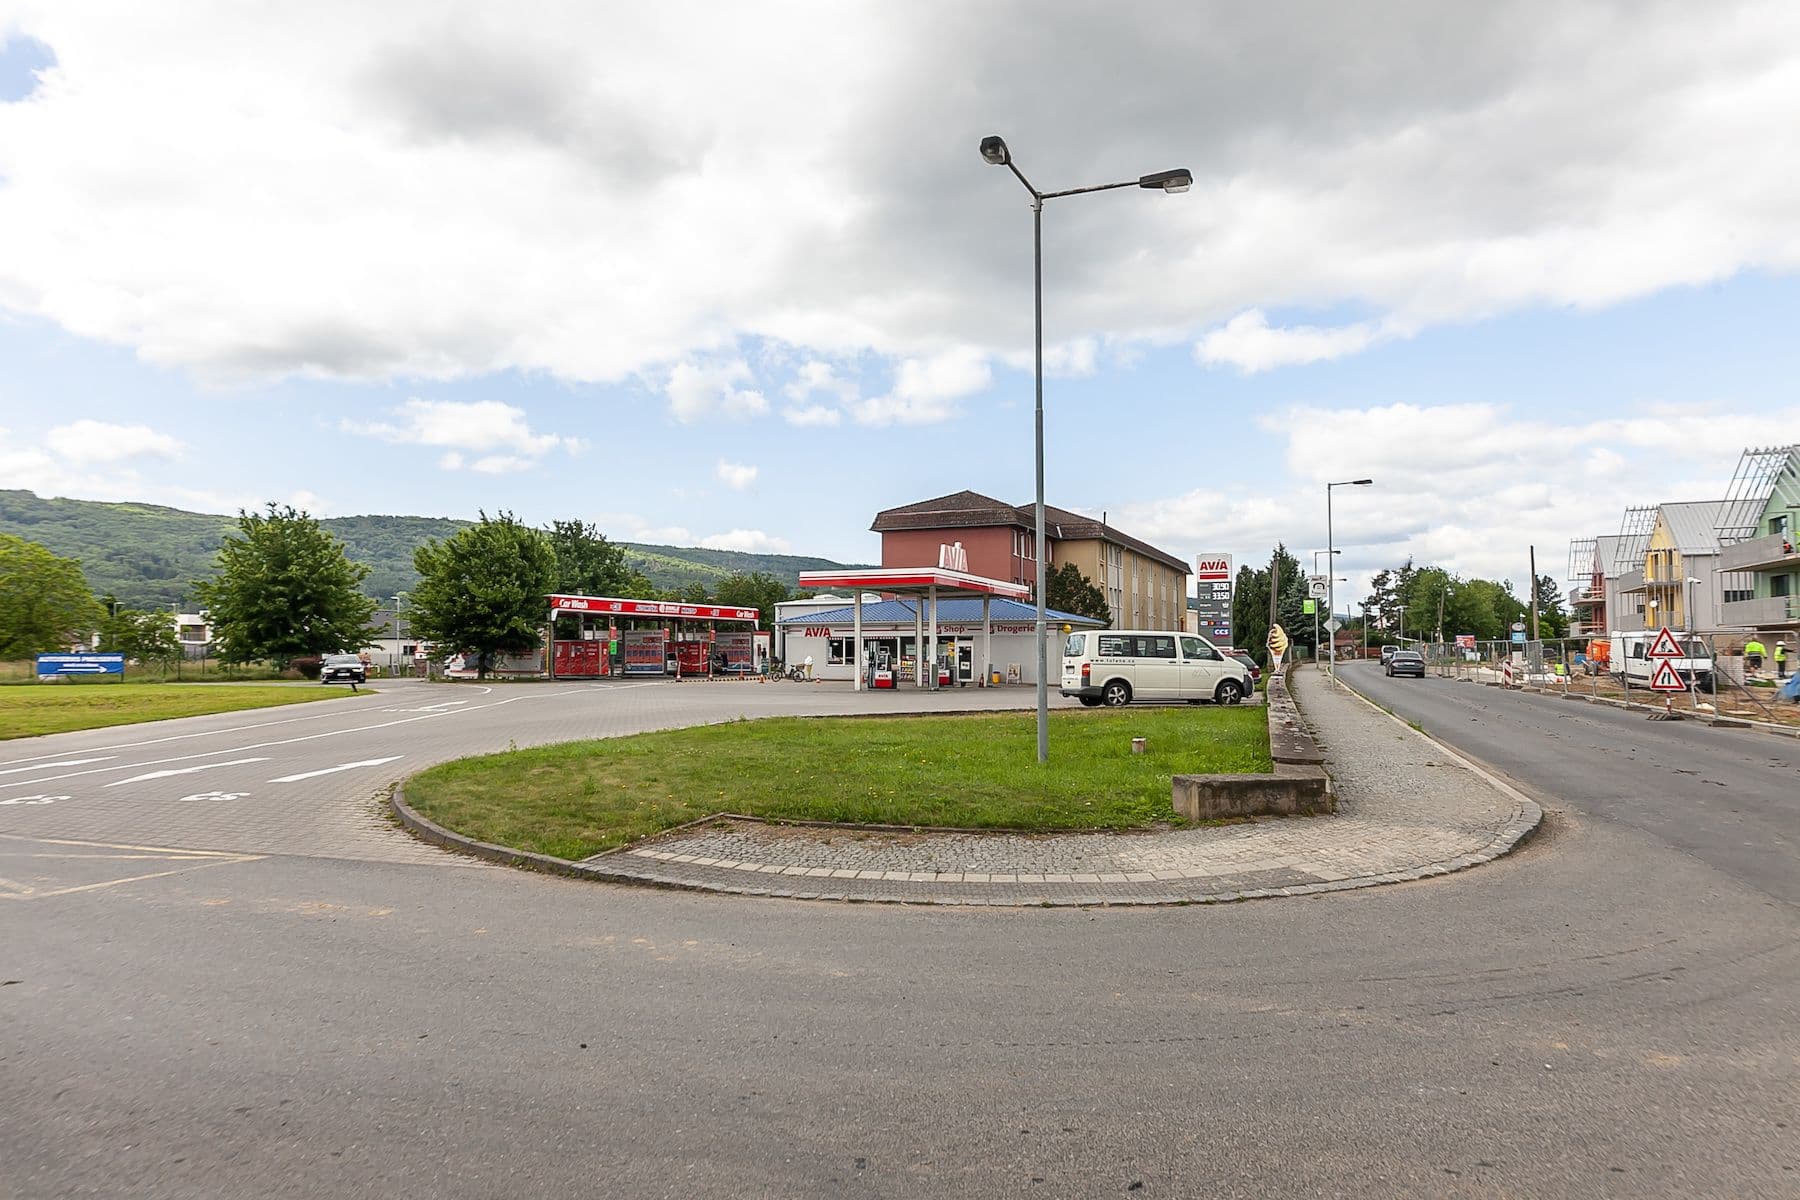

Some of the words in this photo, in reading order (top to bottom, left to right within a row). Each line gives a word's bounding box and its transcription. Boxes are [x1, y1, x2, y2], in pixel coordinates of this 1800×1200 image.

[559, 599, 571, 608] Car
[571, 599, 589, 609] Wash
[943, 624, 965, 634] Shop
[997, 624, 1035, 634] Drogerie
